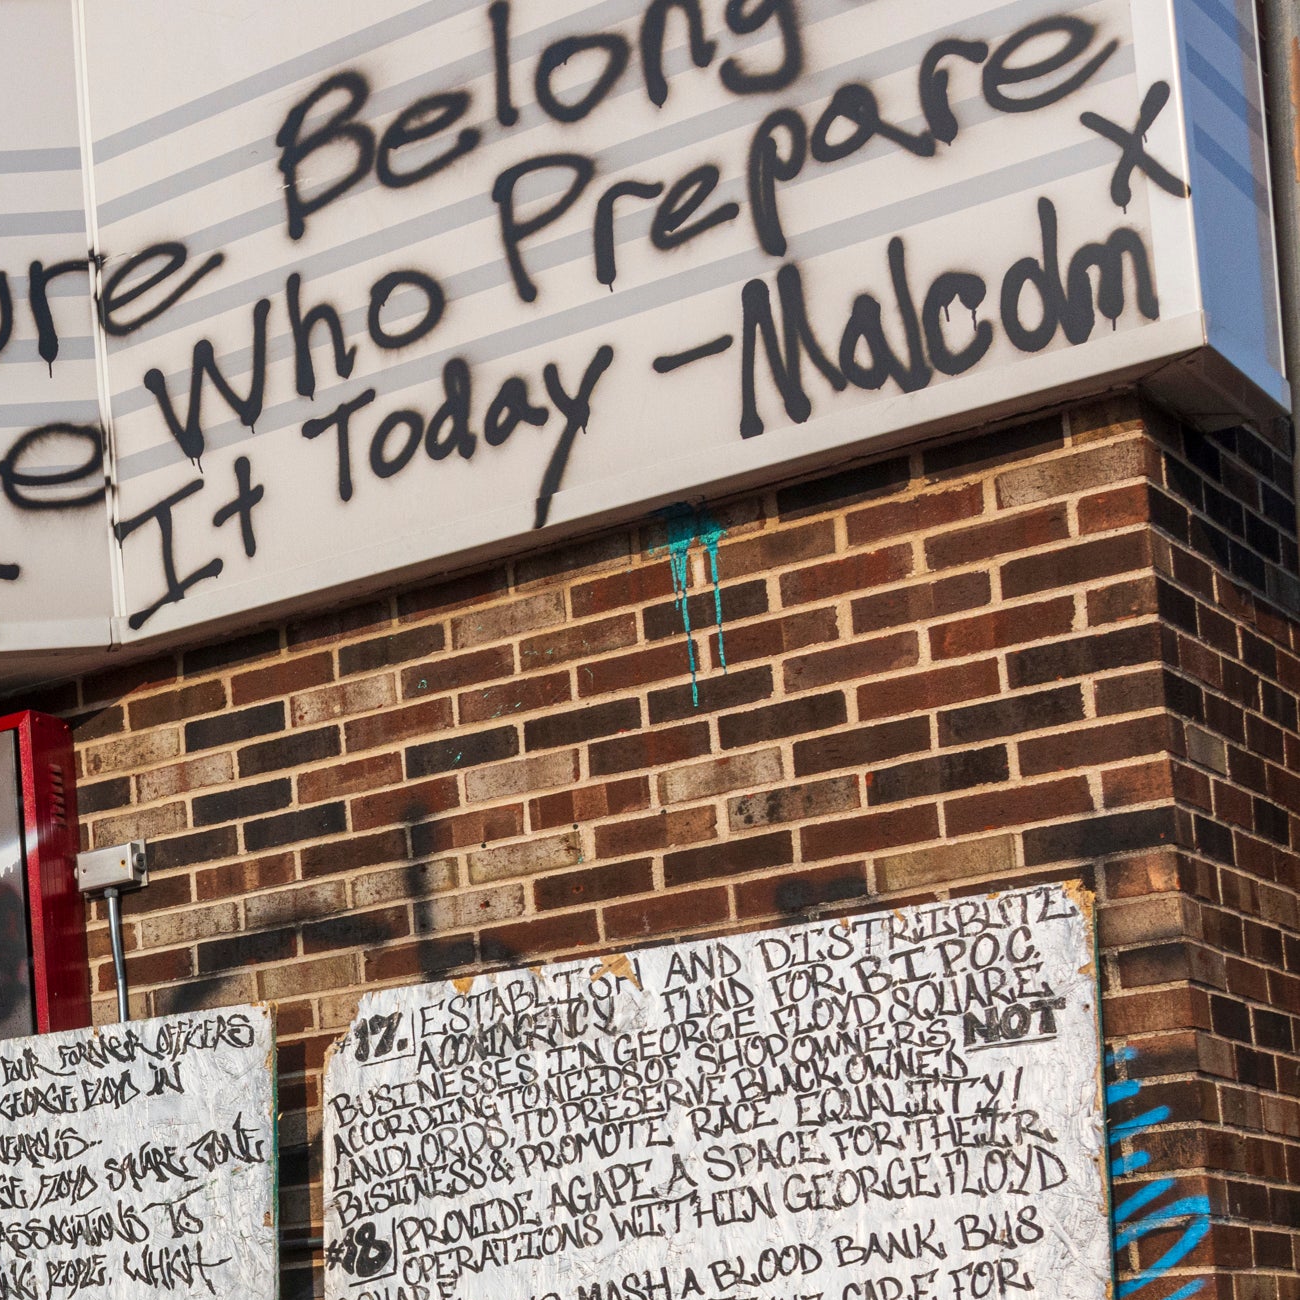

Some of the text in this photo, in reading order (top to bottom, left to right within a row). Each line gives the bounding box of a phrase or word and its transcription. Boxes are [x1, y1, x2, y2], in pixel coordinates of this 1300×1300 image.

[274, 0, 802, 242] Belong
[142, 266, 447, 472] Who
[493, 15, 1119, 303] Prepare
[114, 455, 264, 630] It
[303, 345, 614, 530] Today
[665, 942, 741, 987] AND
[756, 887, 1077, 973] DISTRIBUTE
[0, 1048, 76, 1086] FOUR
[81, 1070, 140, 1111] FLOYD
[329, 962, 1054, 1128] BUSINESSES IN GEORGE FLOYD SQUARE
[398, 1190, 541, 1255] PROVIDE
[551, 1158, 654, 1219] AGAPE
[667, 1153, 697, 1195] A
[703, 1128, 829, 1181] SPACE
[831, 1122, 906, 1159] FOR
[906, 1110, 1058, 1150] THEIR
[402, 1145, 1068, 1286] OPERATIONS WITHIN GEORGE FLOYD
[681, 1268, 701, 1296] A
[708, 1245, 822, 1292] BLOOD
[831, 1219, 947, 1268] BANK
[955, 1205, 1044, 1251] BUS
